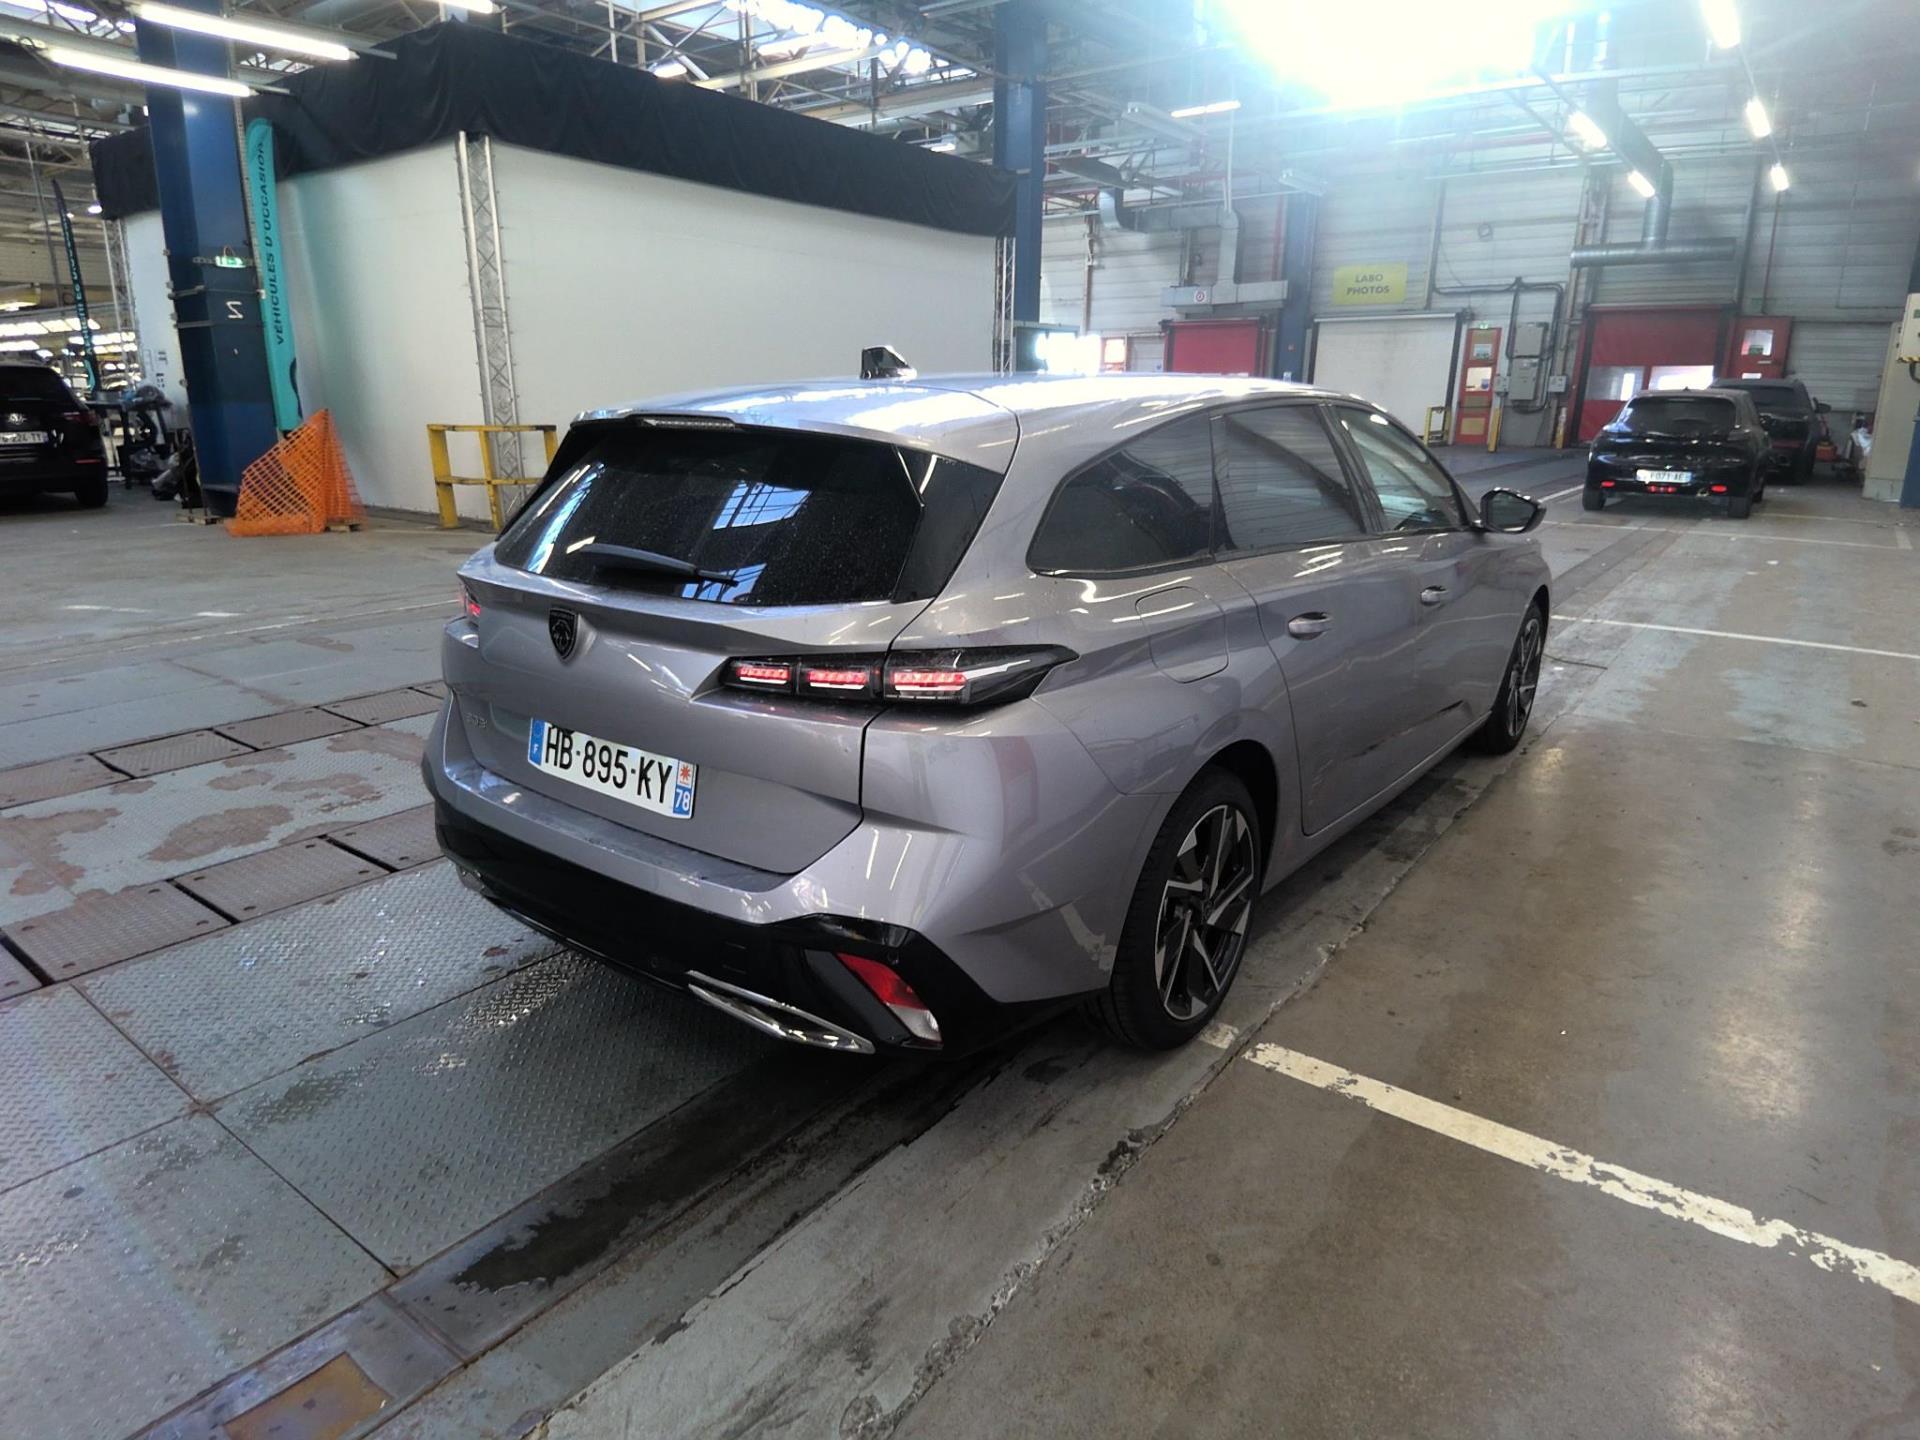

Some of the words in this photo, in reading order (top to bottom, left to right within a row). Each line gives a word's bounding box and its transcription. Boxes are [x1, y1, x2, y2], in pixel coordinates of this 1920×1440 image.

[1354, 273, 1384, 283] LABO
[1345, 285, 1391, 295] PHOTOS
[545, 726, 673, 804] HB-895-KY
[675, 788, 690, 811] 78
